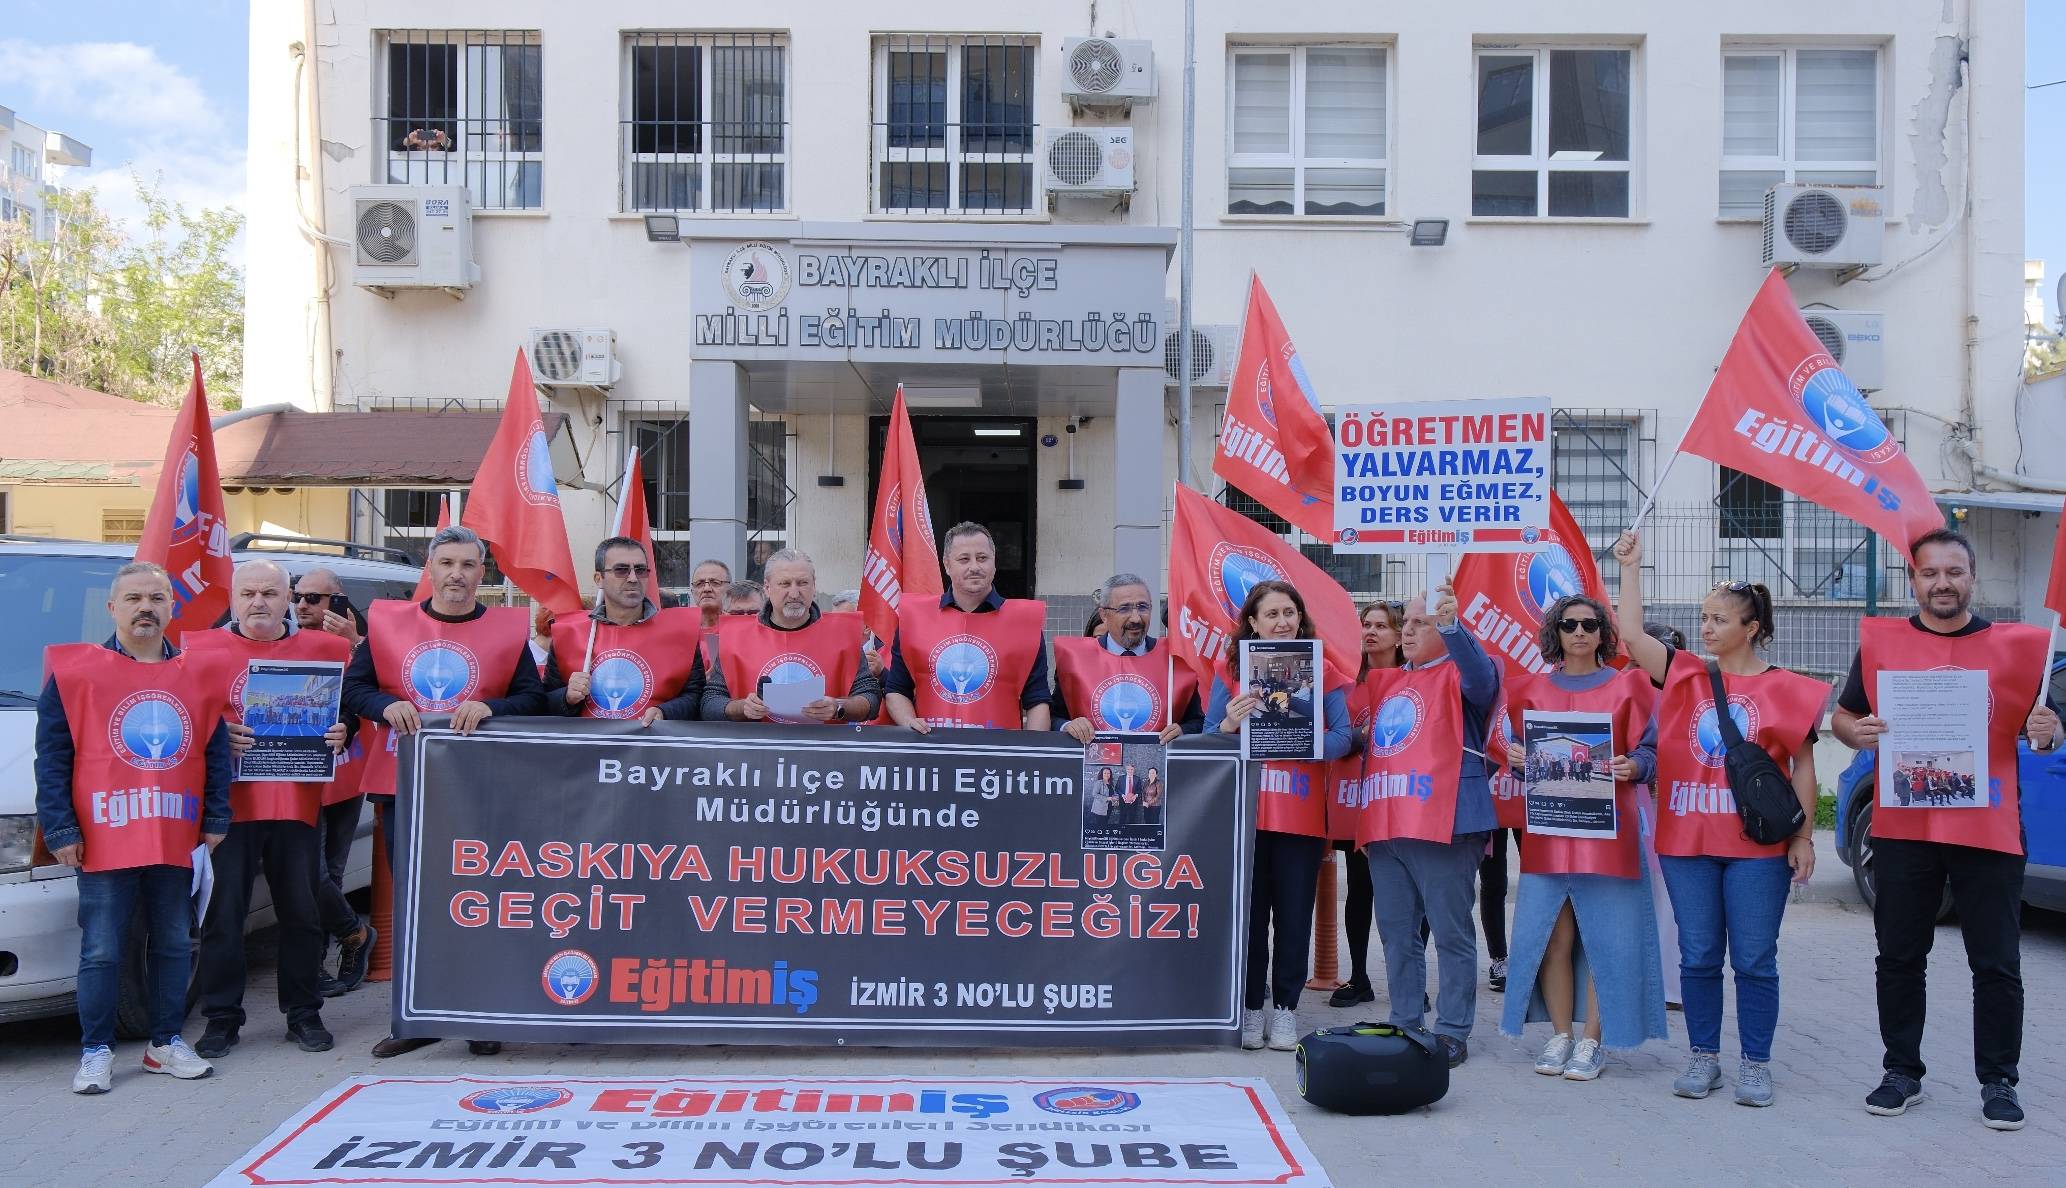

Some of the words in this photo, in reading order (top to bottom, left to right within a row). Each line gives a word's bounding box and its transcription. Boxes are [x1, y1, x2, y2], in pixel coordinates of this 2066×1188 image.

[798, 254, 968, 289] BAYRAKLI
[979, 248, 1058, 297] İLÇE
[695, 305, 789, 347] MİLLİ
[799, 307, 921, 349] EĞİTİM
[934, 310, 1158, 353] MÜDÜRLÜĞÜ
[1340, 411, 1545, 448] ÖĞRETMEN
[1341, 448, 1544, 478] YALVARMAZ,
[1734, 407, 1902, 513] Eğitimiş
[1341, 485, 1429, 502] BOYUN
[1440, 480, 1542, 501] EĞMEZ,
[1360, 506, 1429, 523] DERS
[1438, 501, 1521, 523] VERİR
[597, 758, 761, 791] Bayraklı
[775, 757, 844, 795] İlçe
[858, 765, 940, 793] Milli
[954, 766, 1075, 800] Eğitim
[91, 785, 199, 828] Eğitimiş
[696, 797, 981, 831] Müdürlüğünde
[451, 839, 713, 882] BASKIYA
[728, 845, 1205, 891] HUKUKSUZLUĞA
[449, 884, 646, 939] GEÇİT
[688, 893, 1201, 940] VERMEYECEĞİZ!
[609, 957, 819, 1014] Eğitimiş
[850, 975, 926, 1007] İZMİR
[933, 982, 948, 1007] 3
[1043, 984, 1113, 1015] ŞUBE
[588, 1087, 1009, 1118] Eğitimiş
[311, 1135, 589, 1170] İZMİR
[611, 1142, 665, 1170] 3
[997, 1142, 1239, 1177] ŞUBE
